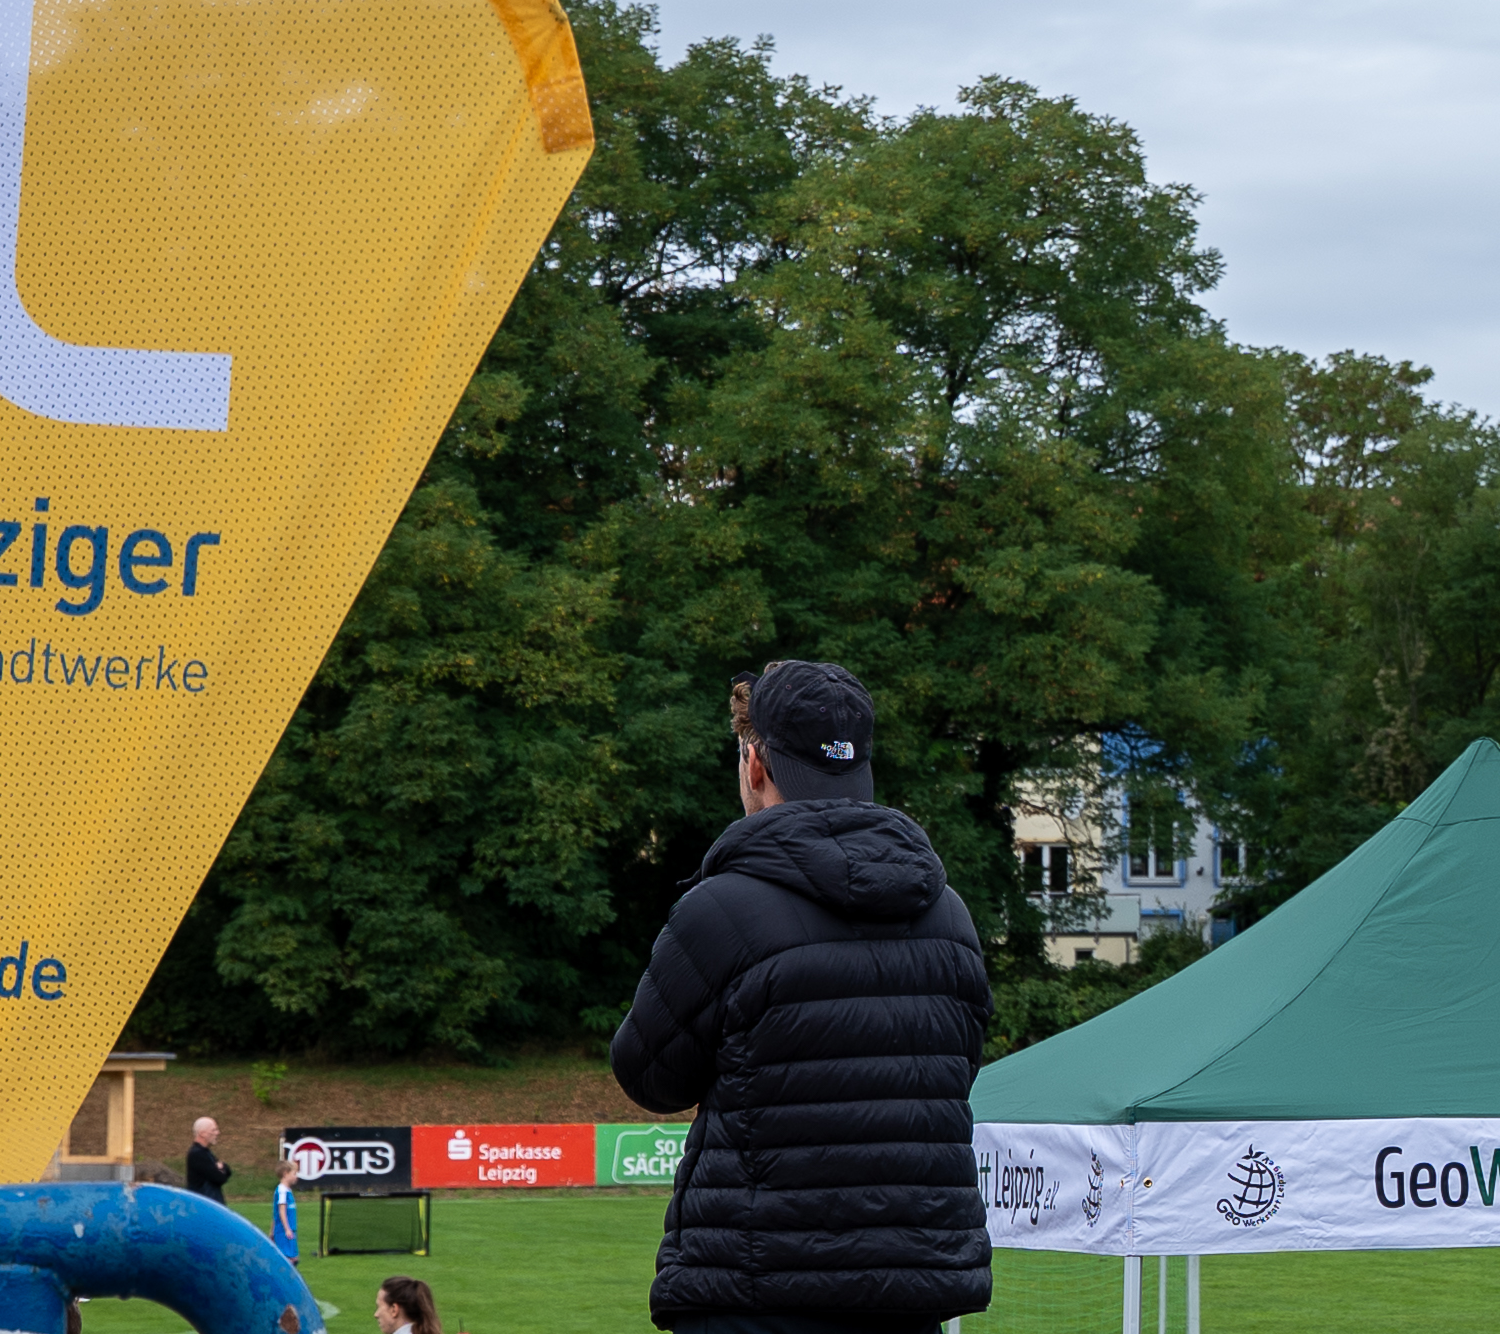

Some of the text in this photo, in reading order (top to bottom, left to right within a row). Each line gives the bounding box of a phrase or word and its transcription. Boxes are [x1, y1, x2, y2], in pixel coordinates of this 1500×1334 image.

[479, 1143, 562, 1163] Sparkasse
[654, 1139, 677, 1155] SO
[478, 1164, 537, 1184] Leipzig
[994, 1148, 1044, 1225] Leipzig
